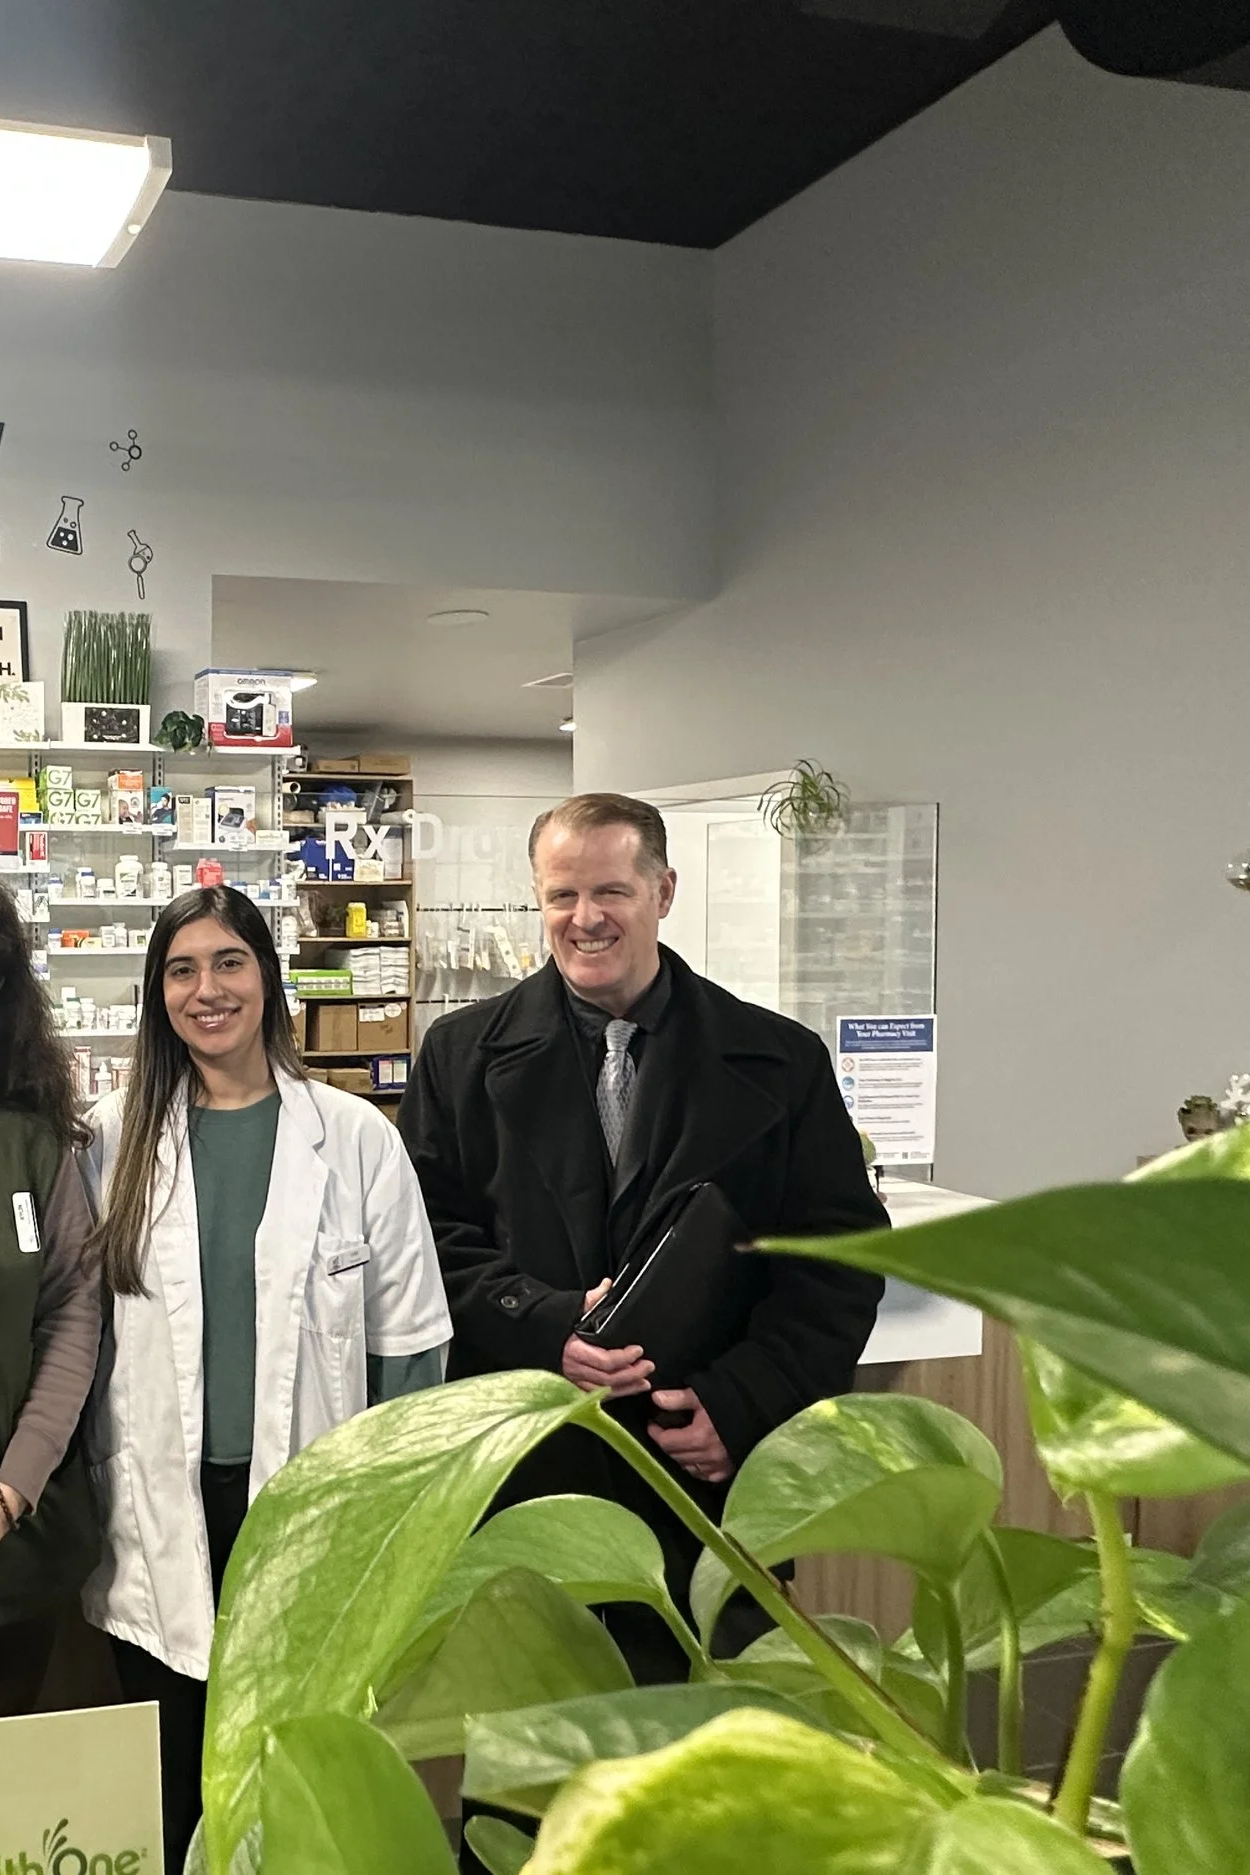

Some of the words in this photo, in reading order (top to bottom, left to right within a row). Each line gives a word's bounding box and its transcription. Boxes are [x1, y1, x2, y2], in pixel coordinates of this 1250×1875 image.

[48, 770, 71, 785] G7
[48, 791, 73, 808] G7
[76, 792, 100, 808] G7
[325, 811, 391, 860] Rx
[847, 1022, 865, 1031] What
[866, 1022, 877, 1031] You
[889, 1022, 910, 1031] Expect
[856, 1030, 870, 1038] Your
[871, 1030, 901, 1039] Pharmacy
